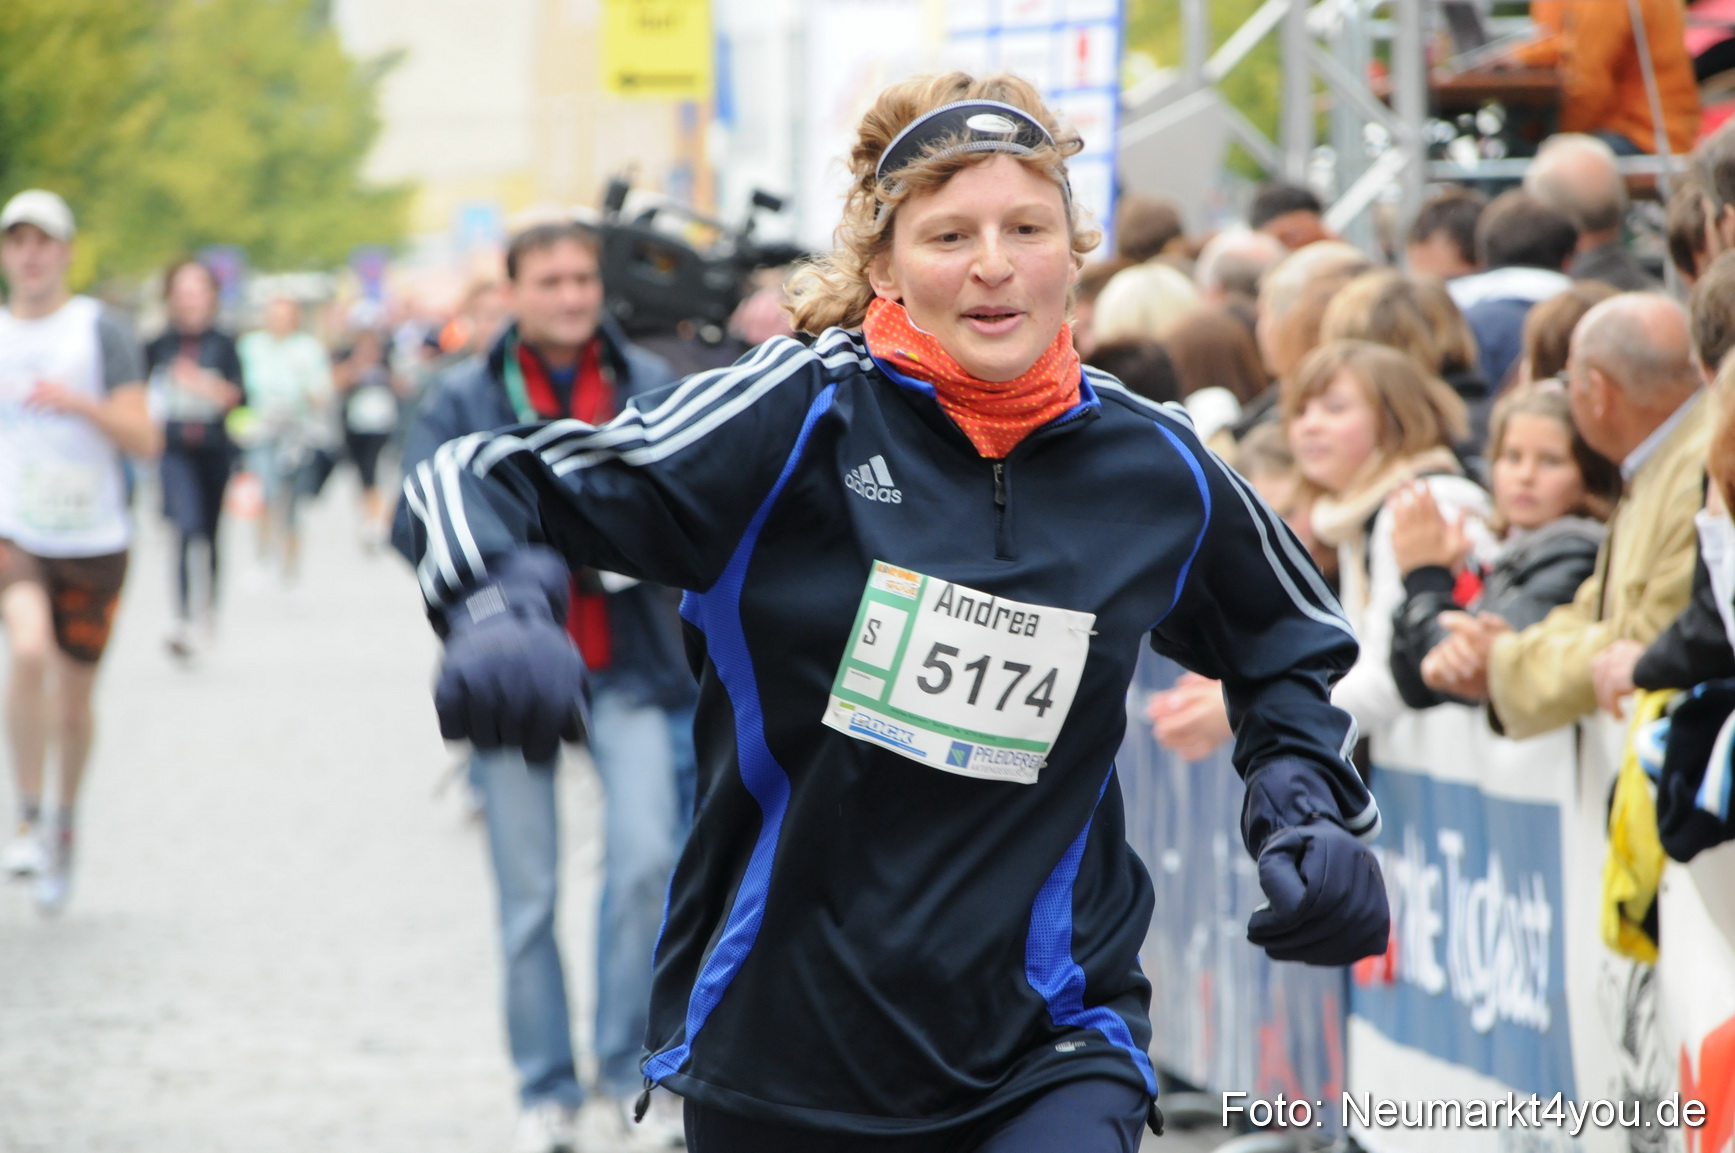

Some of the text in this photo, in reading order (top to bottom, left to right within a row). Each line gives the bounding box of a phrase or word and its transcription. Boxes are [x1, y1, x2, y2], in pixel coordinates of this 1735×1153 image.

[845, 468, 902, 504] adidas
[862, 618, 882, 646] S
[933, 582, 1040, 638] Andrea
[916, 641, 1059, 718] 5174
